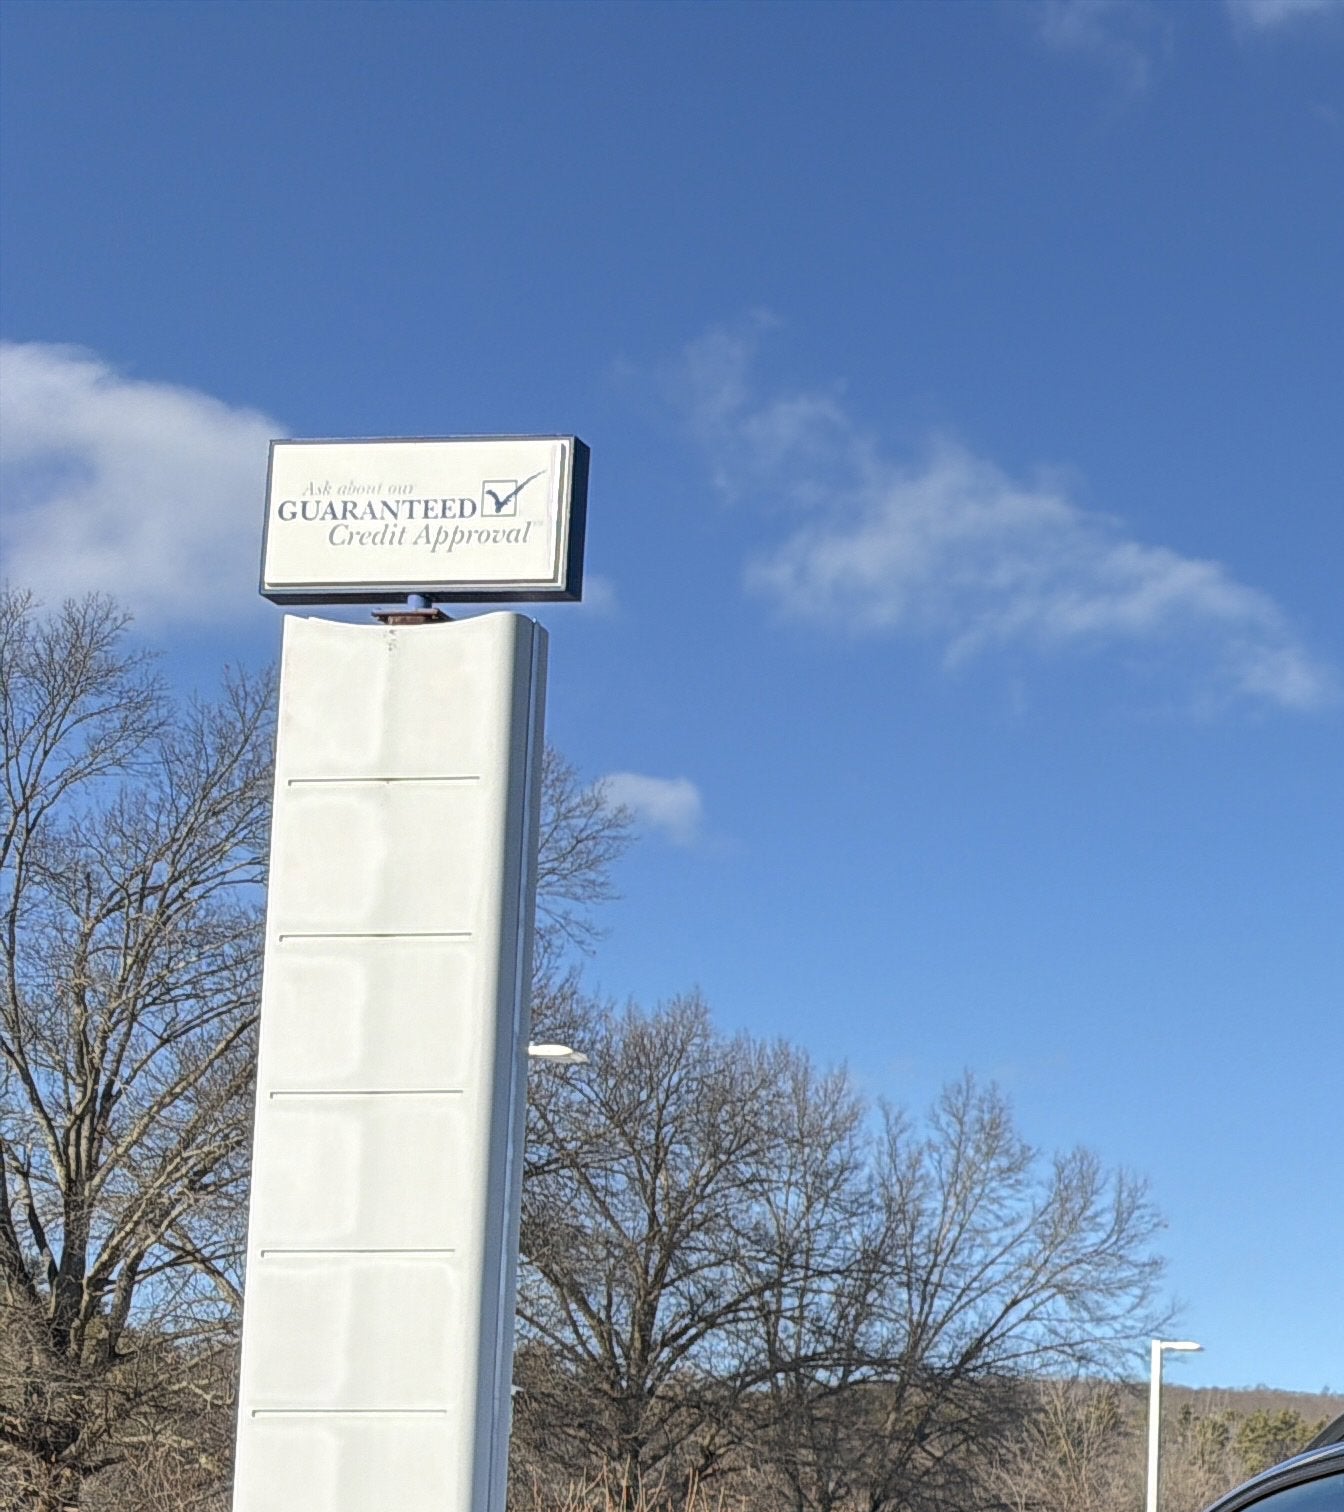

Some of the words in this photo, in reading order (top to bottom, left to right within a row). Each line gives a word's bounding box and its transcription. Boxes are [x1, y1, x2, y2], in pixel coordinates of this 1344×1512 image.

[302, 480, 332, 496] Ask
[337, 480, 382, 496] about
[277, 498, 477, 521] GUARANTEED
[328, 523, 406, 546] Credit
[412, 521, 532, 553] Approval
